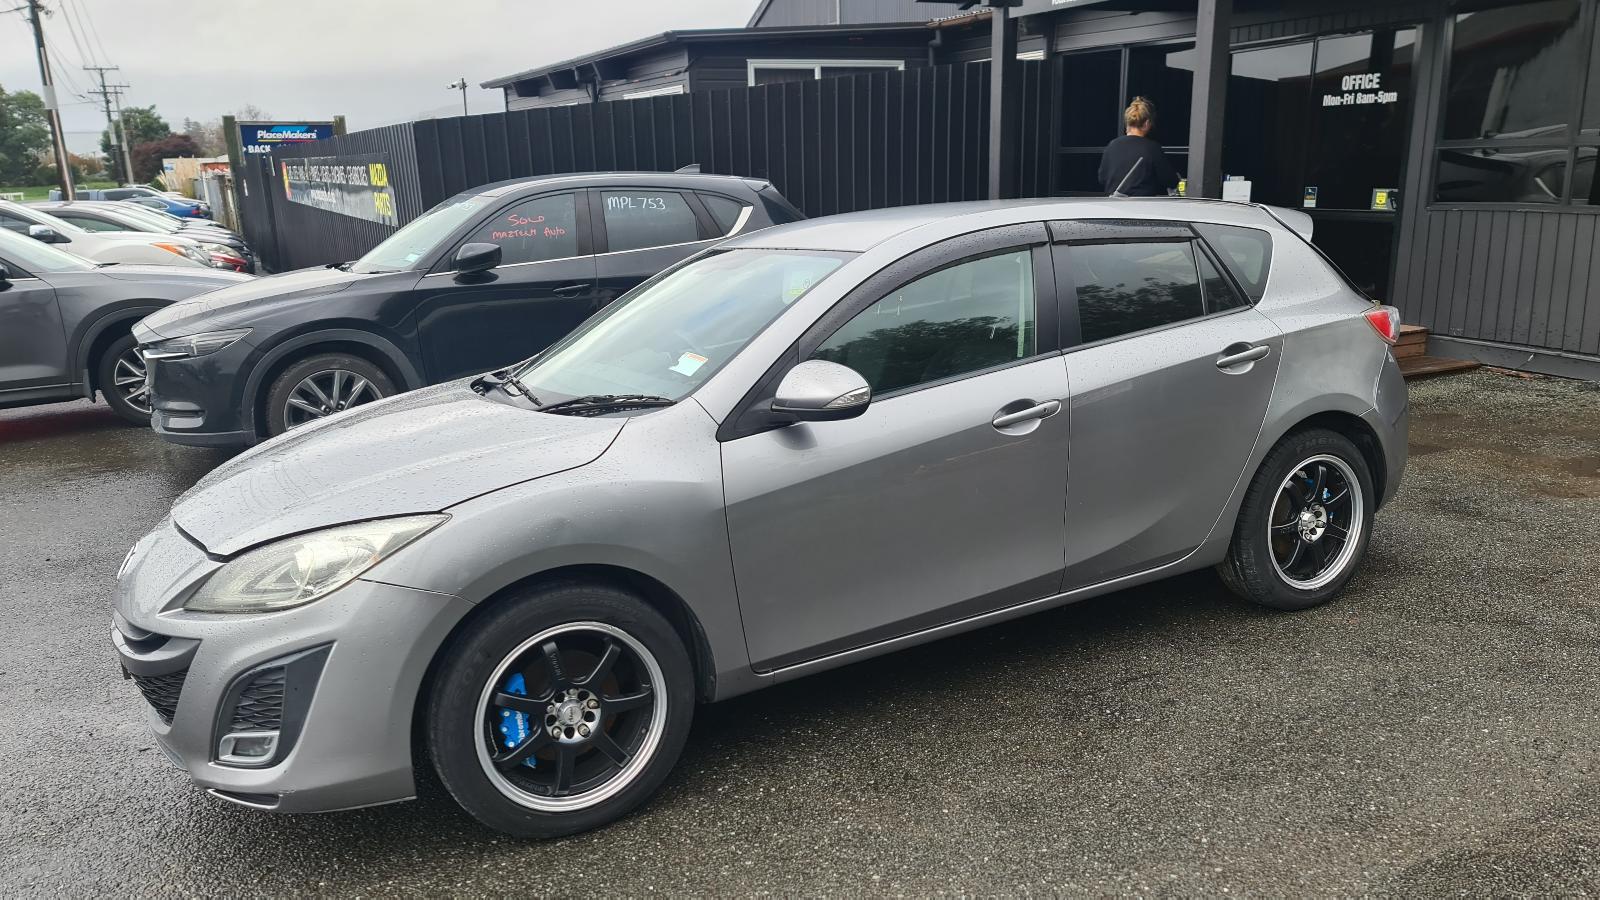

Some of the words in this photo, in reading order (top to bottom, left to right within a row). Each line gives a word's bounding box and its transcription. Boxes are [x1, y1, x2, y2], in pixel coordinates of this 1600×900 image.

[1341, 73, 1381, 90] OFFICE
[1323, 93, 1354, 106] Mon-Fri
[1356, 91, 1398, 104] 8am-5pm
[257, 129, 317, 139] PlaceMakers
[247, 144, 271, 153] BACK
[369, 163, 388, 187] MAZDA
[374, 192, 391, 216] PARTS
[607, 196, 636, 210] MPL
[637, 197, 666, 210] 753
